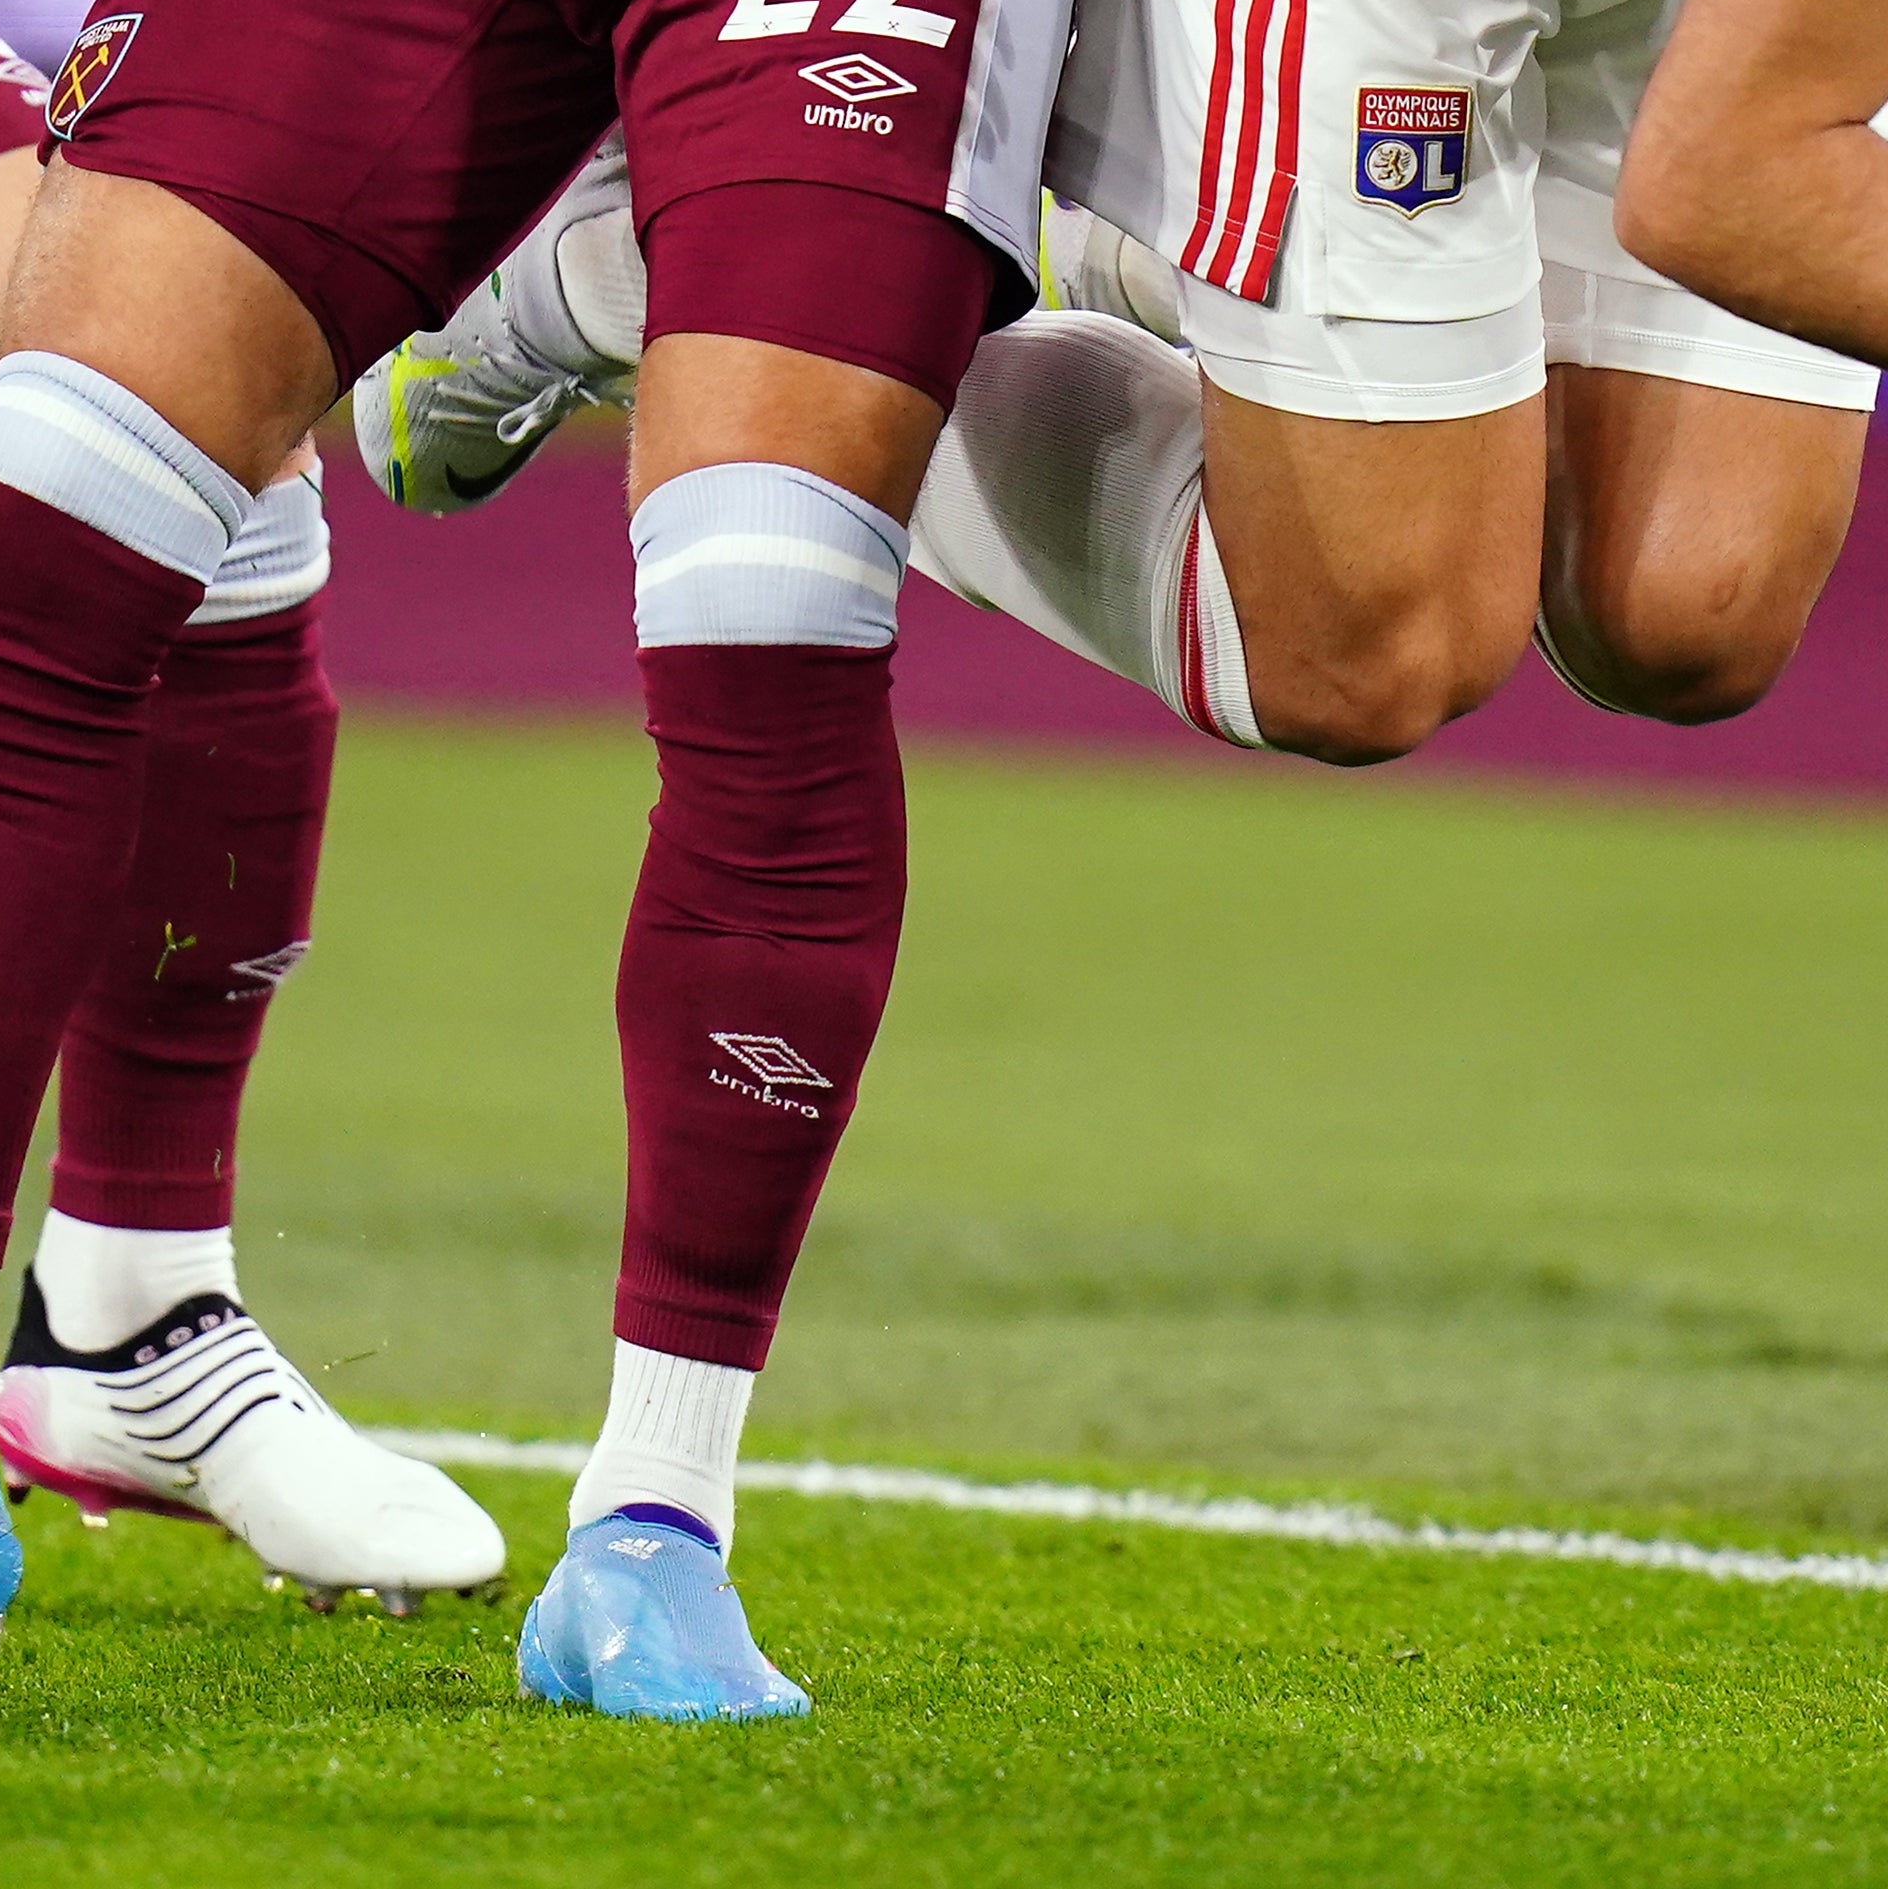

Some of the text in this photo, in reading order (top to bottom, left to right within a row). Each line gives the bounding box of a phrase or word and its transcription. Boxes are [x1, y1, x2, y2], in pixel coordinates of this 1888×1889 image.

[1365, 94, 1461, 112] OLYMPIQUE
[804, 103, 894, 135] umbro
[1365, 110, 1460, 128] LYONNAIS
[709, 1069, 820, 1118] umbro
